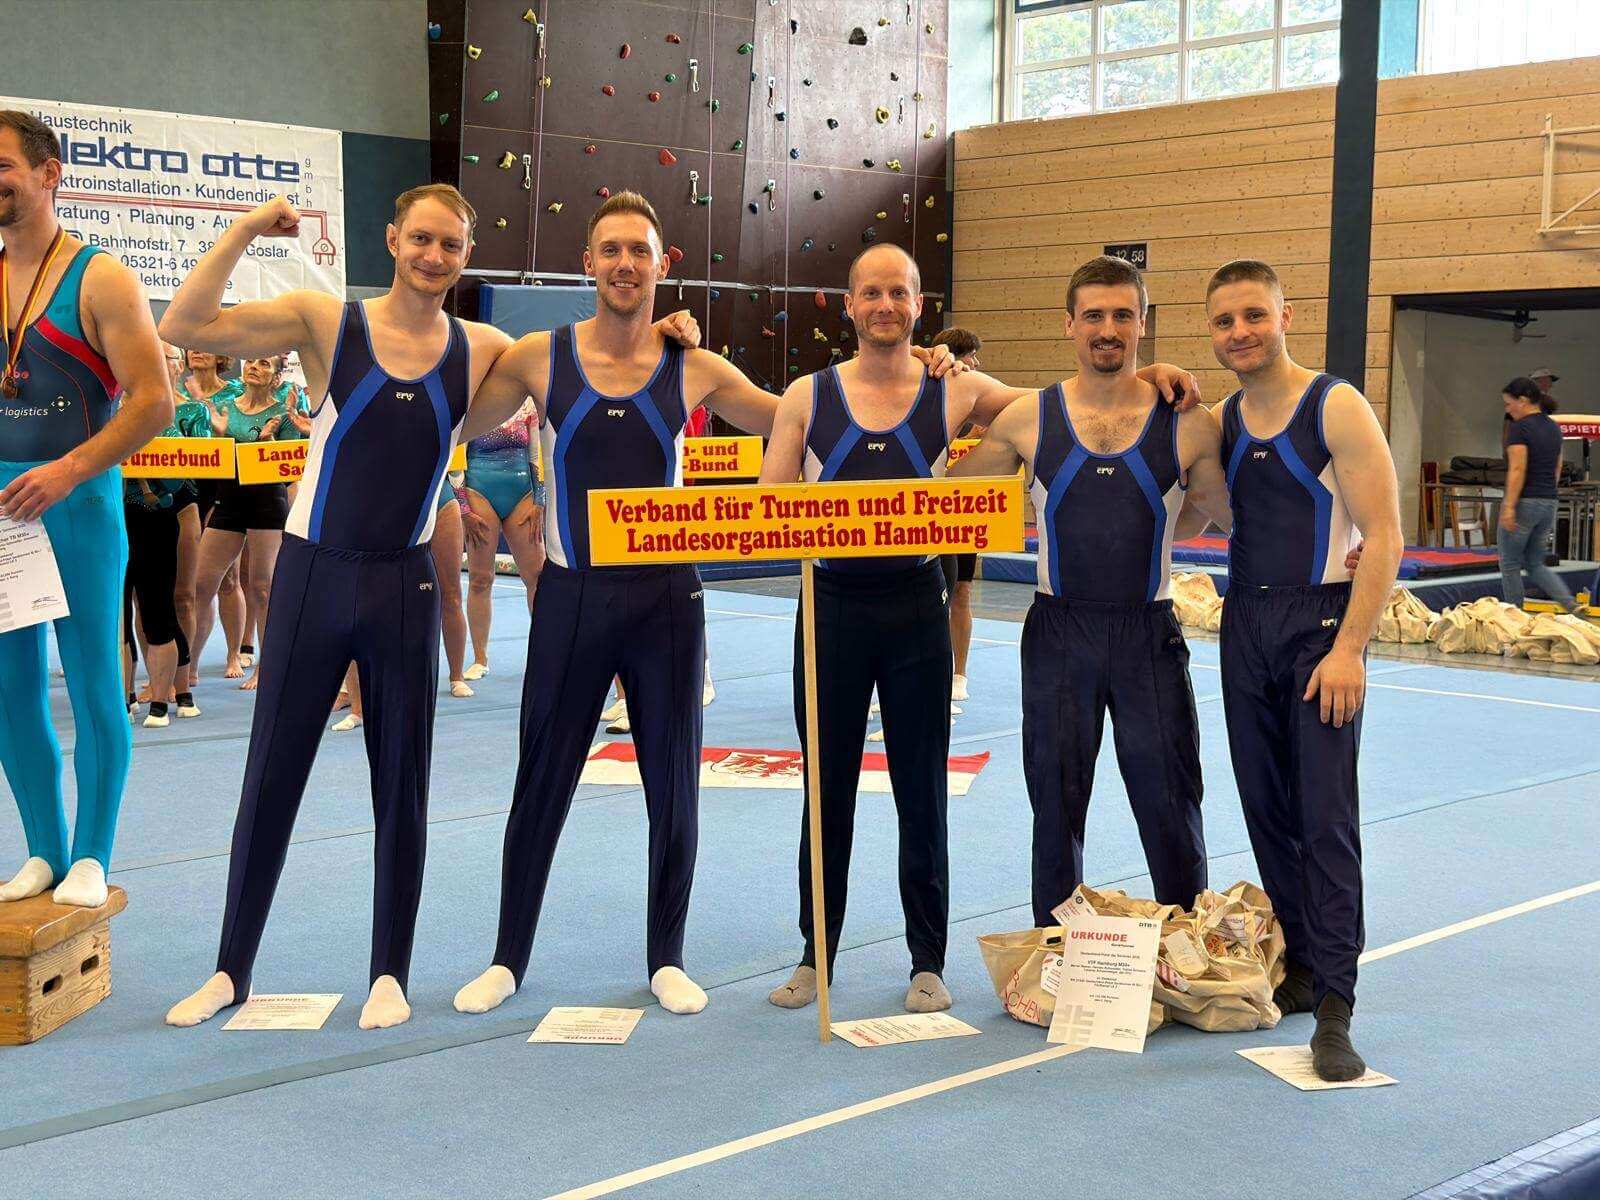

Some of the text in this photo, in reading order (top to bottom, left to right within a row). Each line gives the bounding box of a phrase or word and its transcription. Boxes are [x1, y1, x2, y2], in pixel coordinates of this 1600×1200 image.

[60, 132, 300, 182] lektro otte
[60, 174, 300, 206] ktroinstallation Kundendiest
[56, 205, 110, 224] ratung
[130, 208, 195, 230] Planung
[89, 233, 173, 251] Bahnhofstr.
[177, 239, 186, 251] 7
[245, 243, 290, 257] Goslar
[4, 406, 49, 419] logistics
[1559, 424, 1600, 434] SPIET
[121, 448, 221, 467] urnerbund
[702, 441, 739, 456] und
[682, 458, 739, 473] -Bund
[606, 488, 1008, 524] Verband für Turnen und Freizeit
[626, 520, 988, 555] Landesorganisation Hamburg
[1071, 930, 1128, 943] URKUNDE
